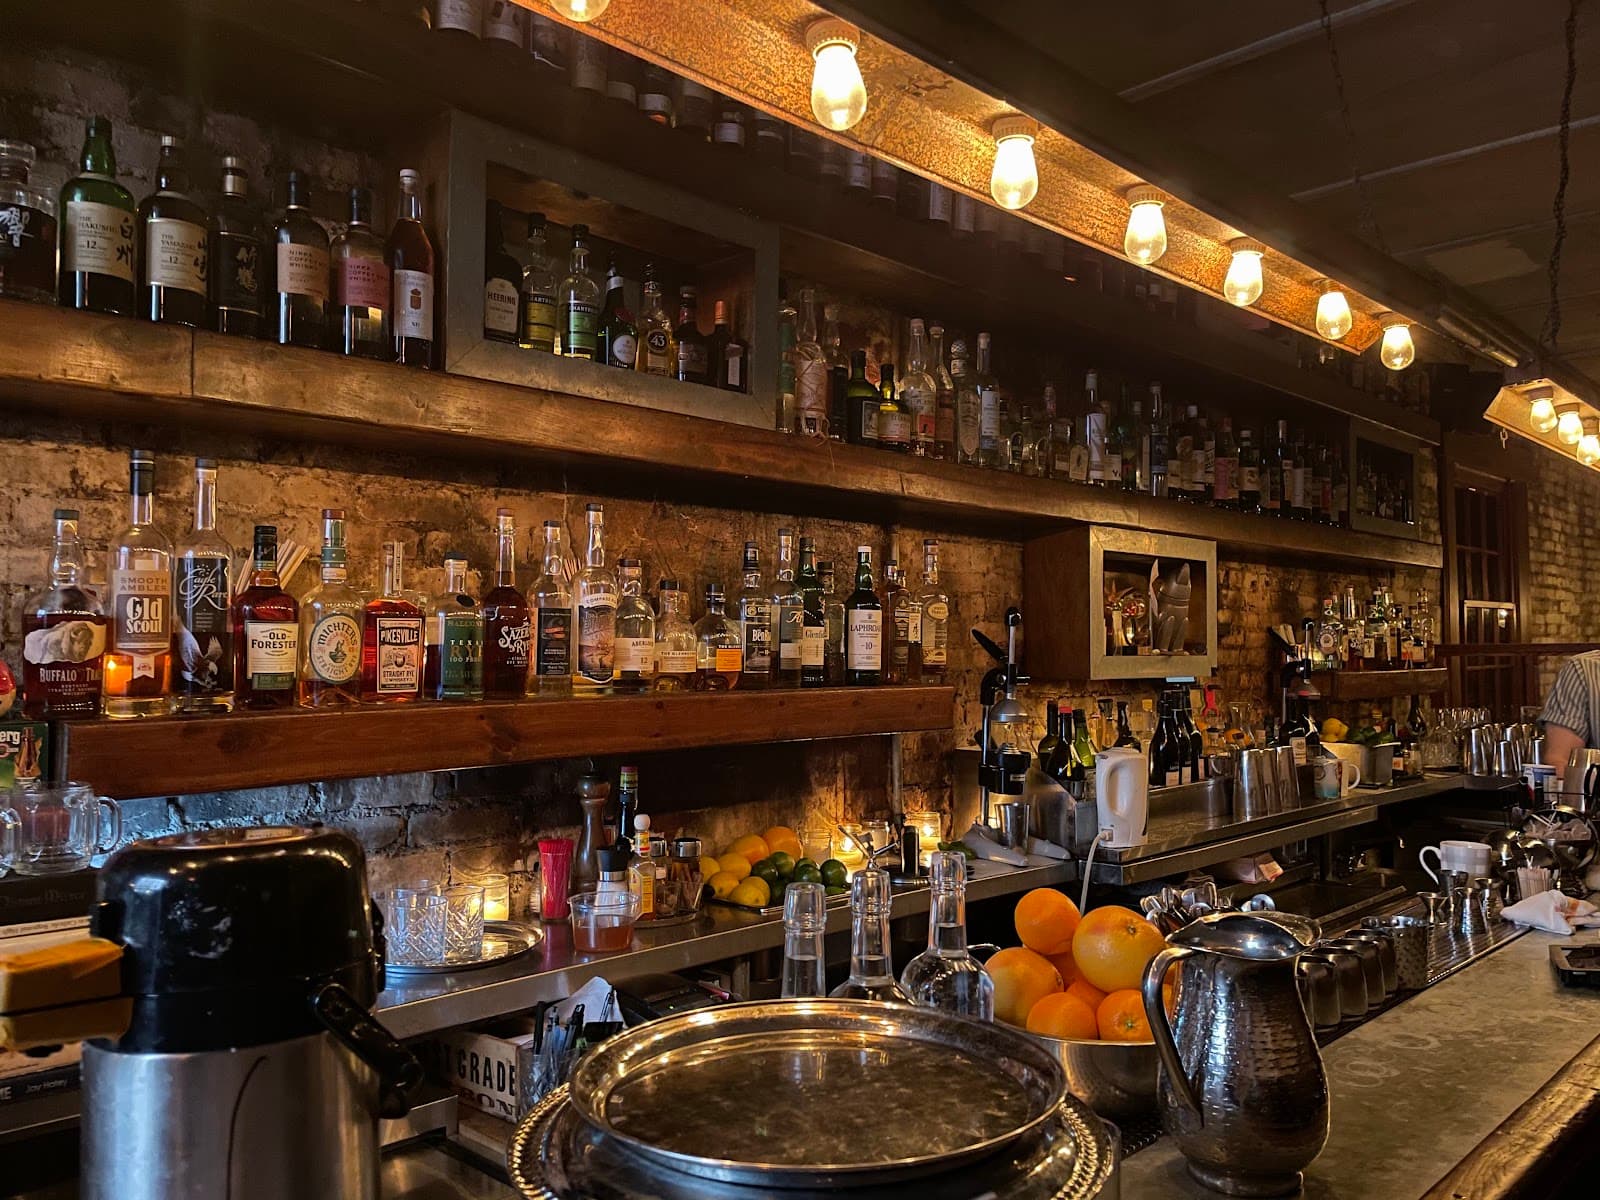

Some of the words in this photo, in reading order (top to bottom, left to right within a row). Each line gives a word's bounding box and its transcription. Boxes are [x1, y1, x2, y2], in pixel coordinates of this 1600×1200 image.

[86, 240, 97, 249] 12
[169, 256, 179, 264] 12
[650, 335, 665, 347] 43
[120, 576, 168, 584] SMOOTH
[126, 596, 163, 620] Old
[126, 619, 163, 634] Scout
[268, 631, 287, 640] OLD
[380, 628, 419, 643] PIKESVILLE
[252, 640, 297, 649] FORESTER
[865, 641, 873, 650] 10
[39, 667, 77, 683] BUFFALO
[458, 1049, 516, 1097] GRADE
